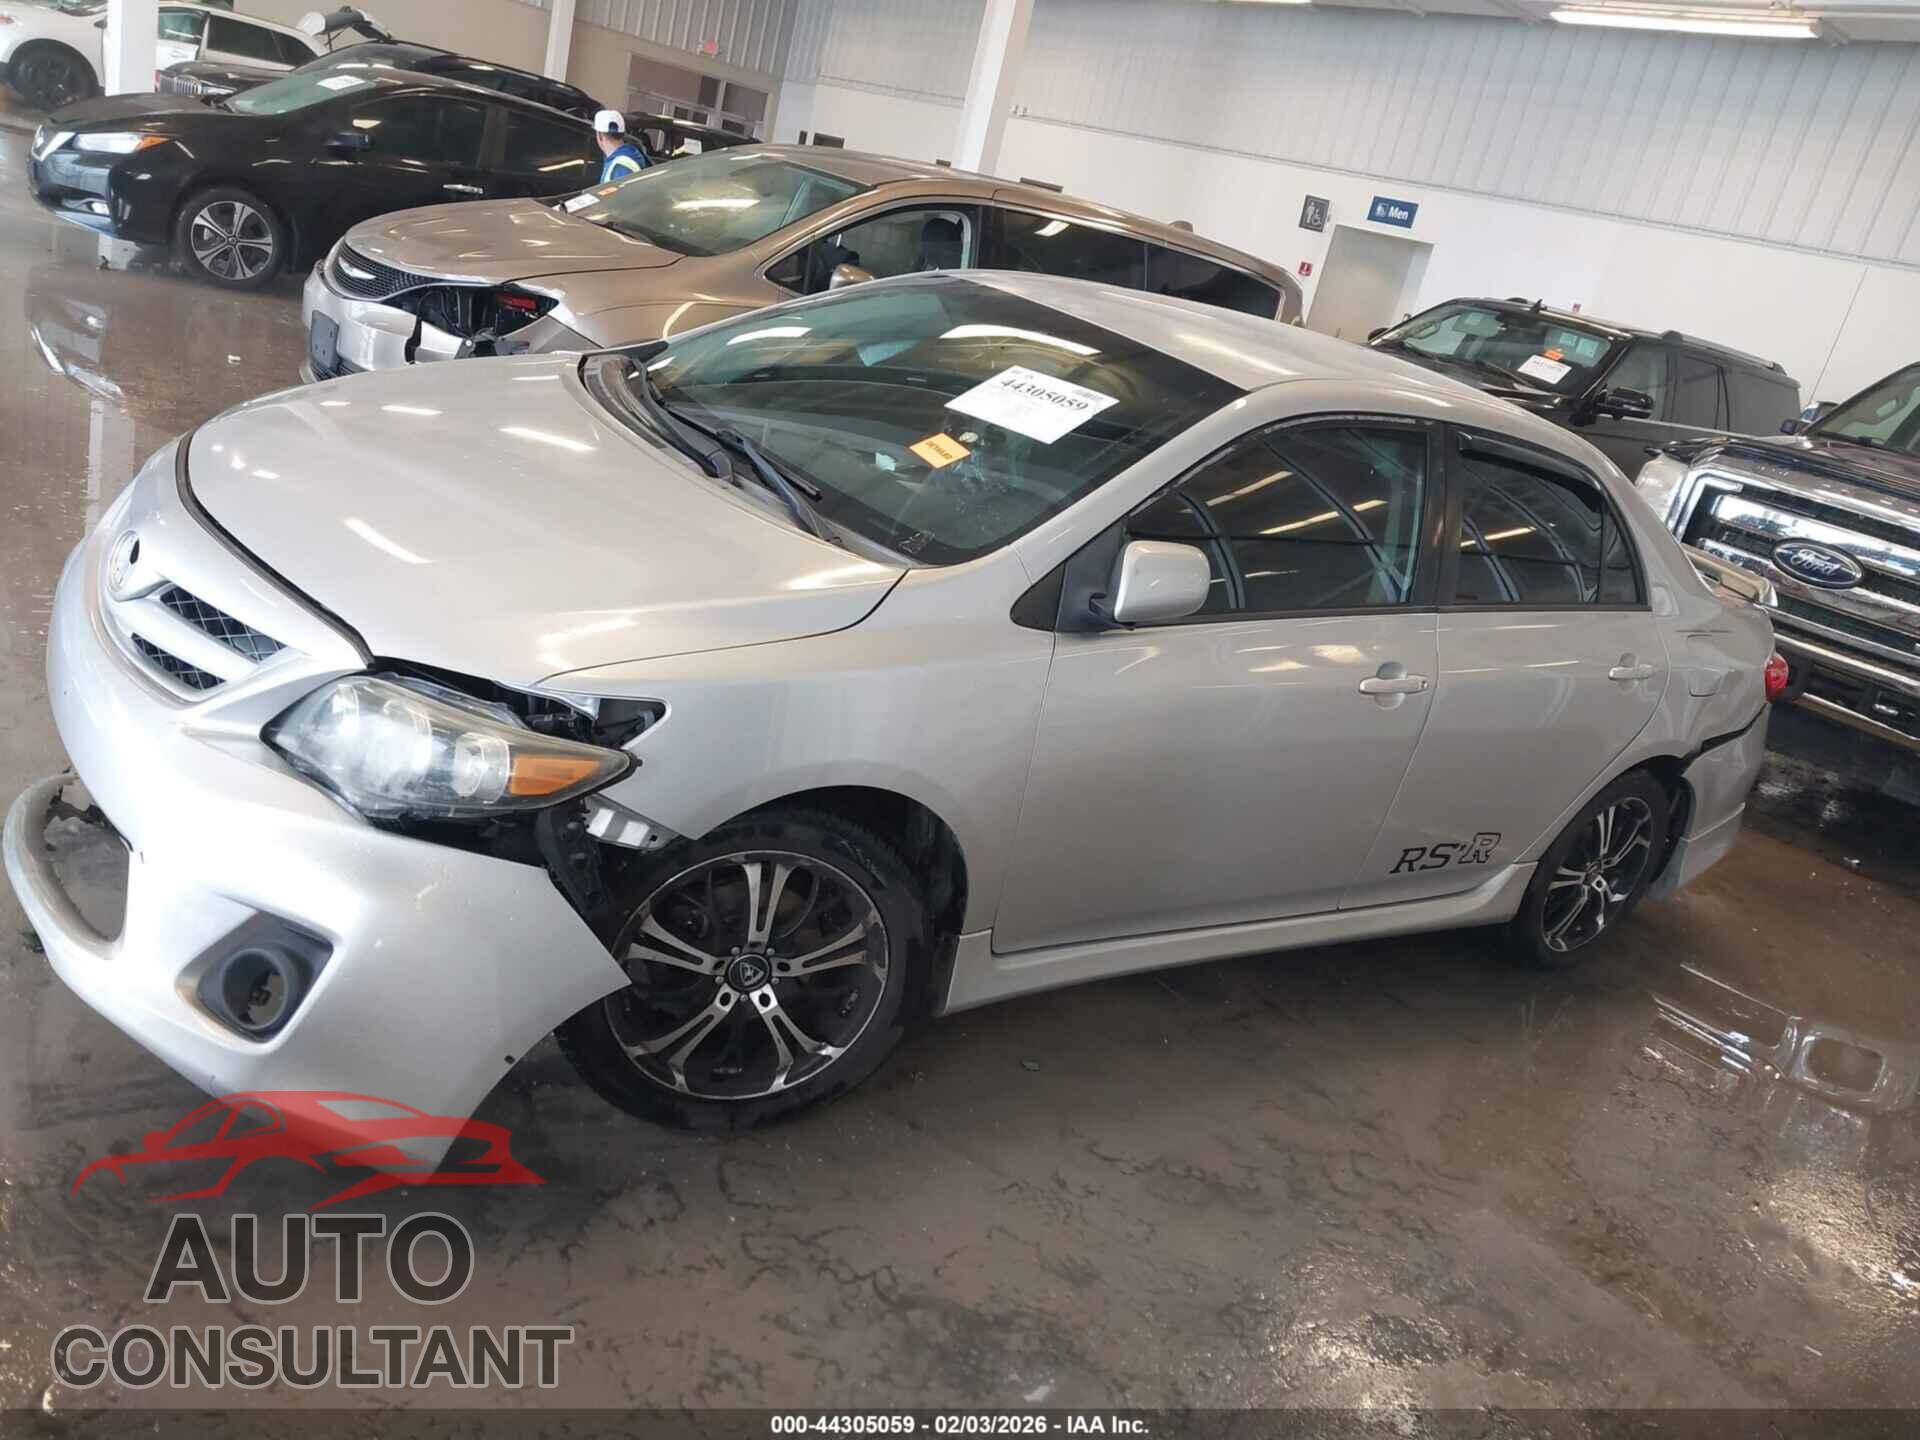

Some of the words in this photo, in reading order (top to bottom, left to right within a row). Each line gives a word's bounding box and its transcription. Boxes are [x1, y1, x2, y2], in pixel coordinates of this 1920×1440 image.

[1388, 205, 1410, 221] Men
[1000, 379, 1090, 410] 44305059
[1790, 548, 1841, 576] Ford
